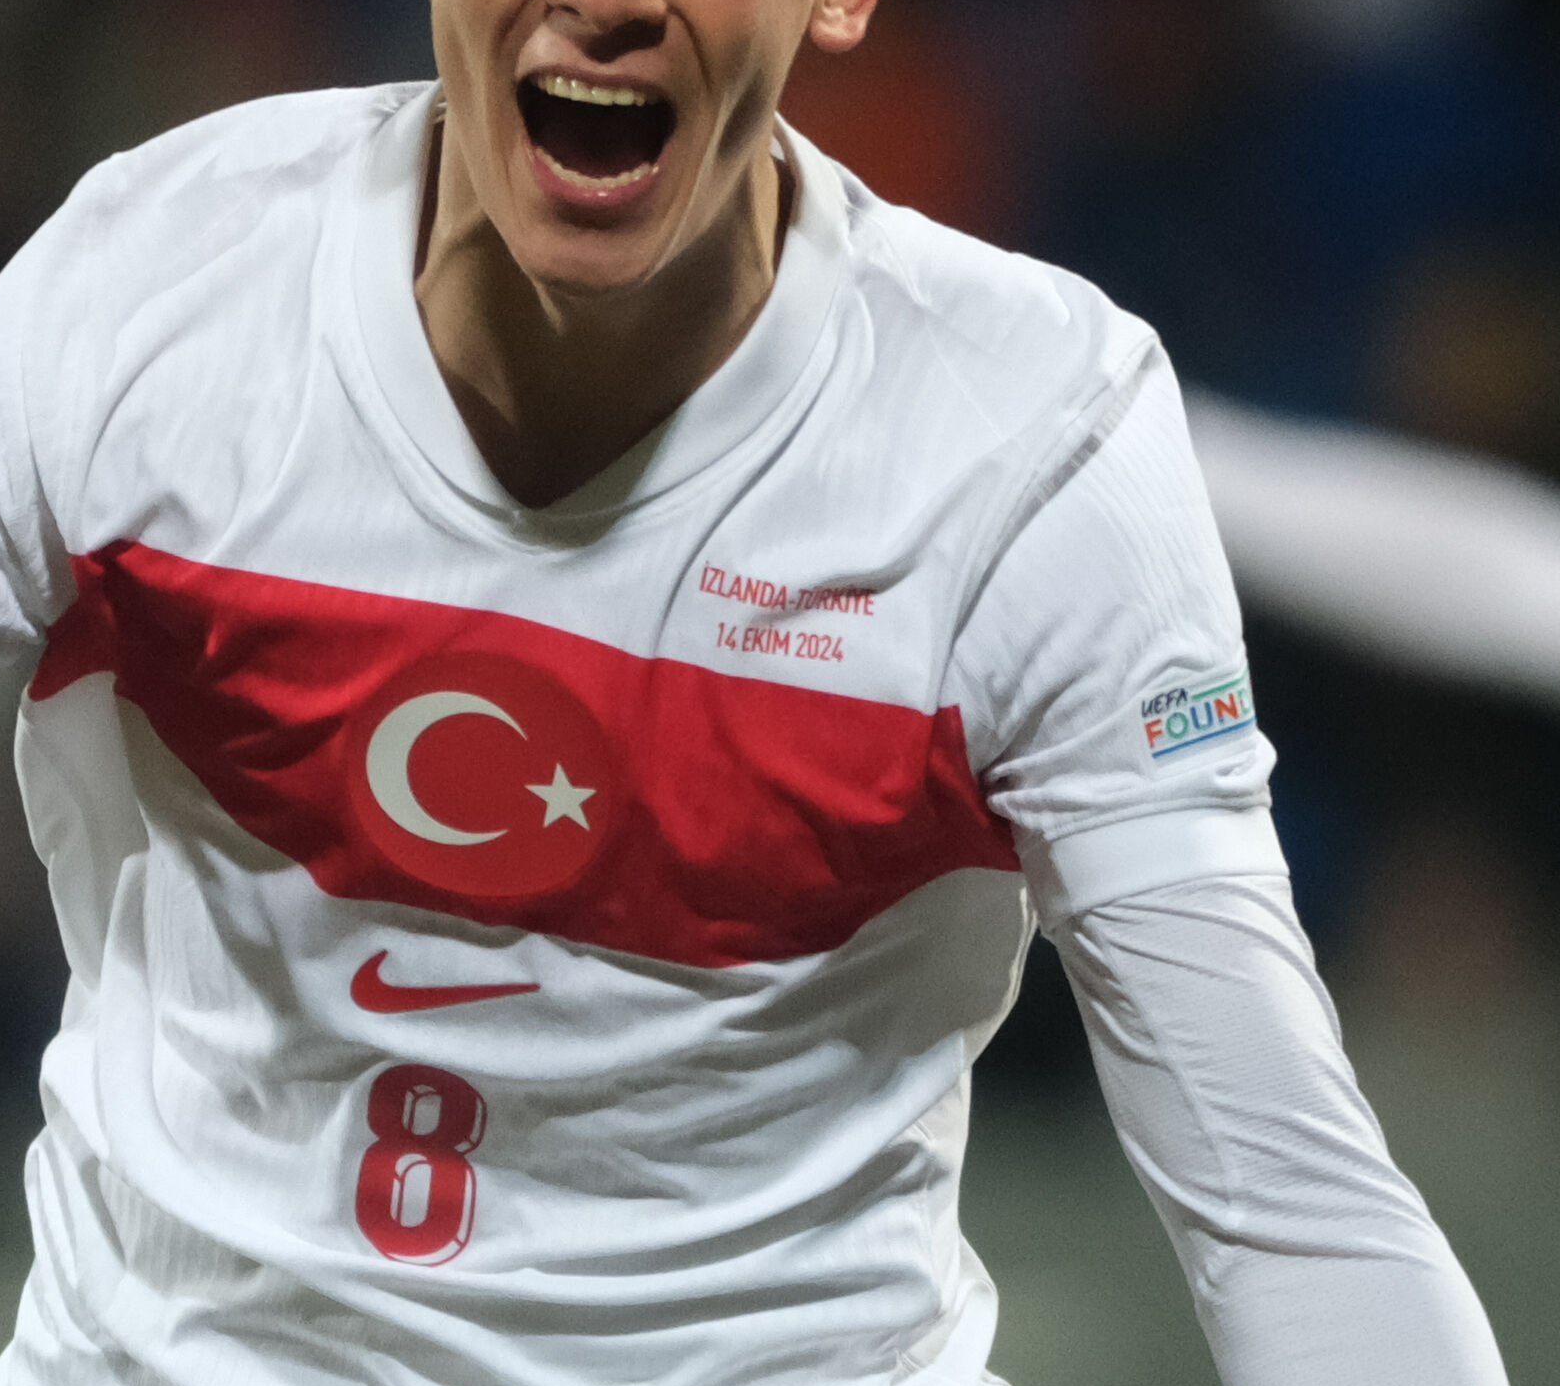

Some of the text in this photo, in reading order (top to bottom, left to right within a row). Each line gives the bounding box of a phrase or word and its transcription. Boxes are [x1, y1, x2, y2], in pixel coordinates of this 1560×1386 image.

[716, 622, 844, 662] 14 EKİM 2024
[1141, 688, 1188, 718] UEFA
[355, 1064, 488, 1267] 8
